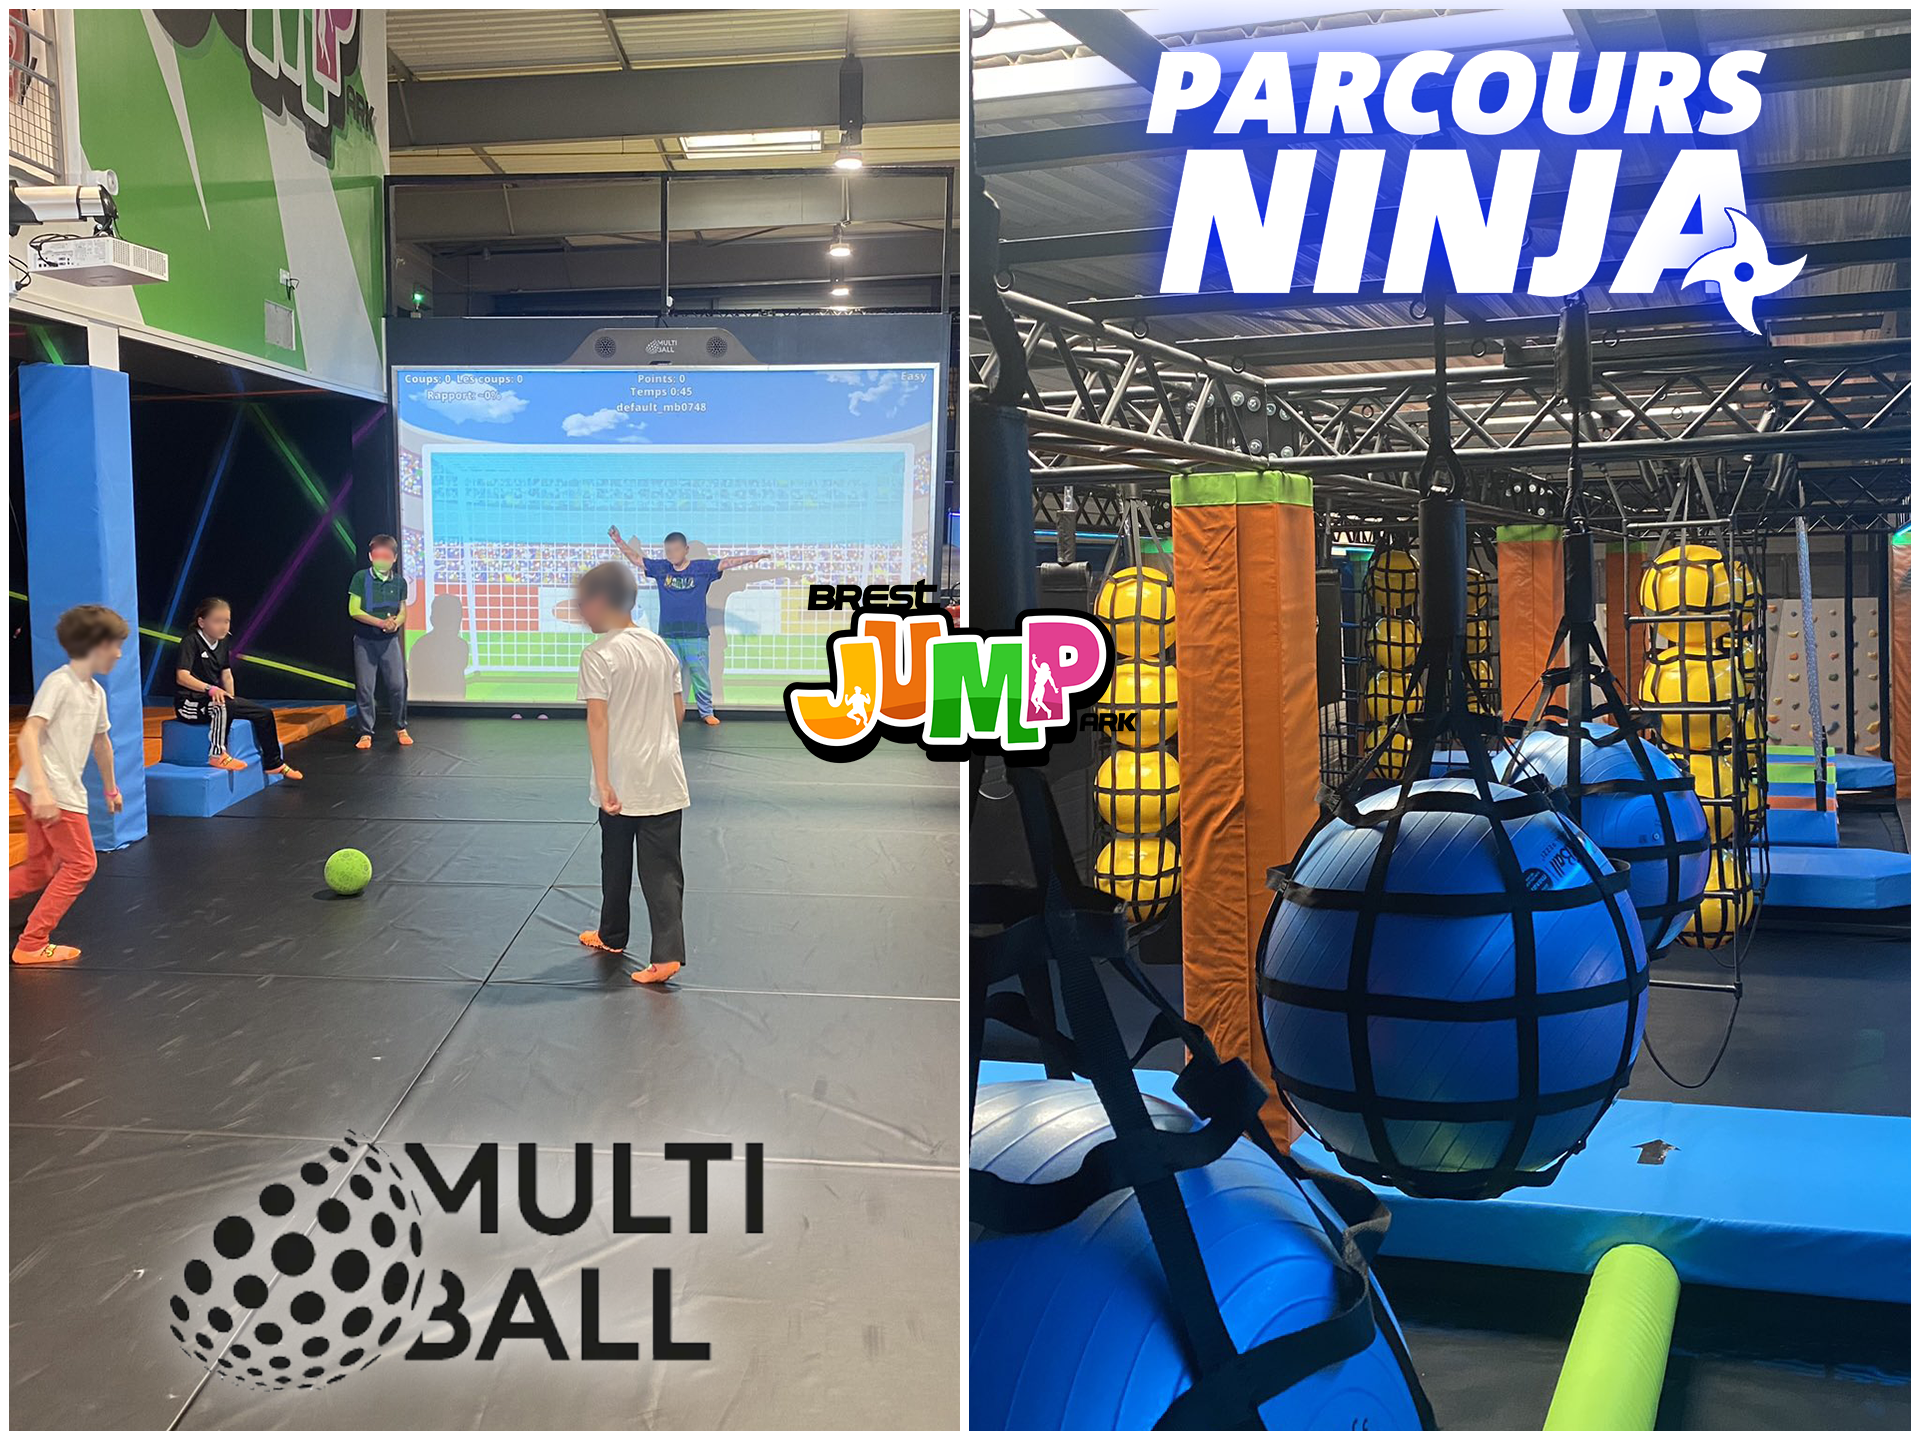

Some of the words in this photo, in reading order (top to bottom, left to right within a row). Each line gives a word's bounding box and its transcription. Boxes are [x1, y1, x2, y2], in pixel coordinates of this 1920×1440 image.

[346, 85, 375, 138] ARK
[658, 339, 678, 347] MULTI
[404, 374, 442, 385] Coups:
[445, 374, 451, 384] 0
[456, 374, 476, 384] Les
[478, 374, 514, 385] coups:
[516, 374, 523, 384] 0
[637, 374, 676, 384] Points:
[679, 374, 686, 384] 0
[900, 371, 927, 384] Easy
[427, 390, 476, 403] Rapport:
[630, 387, 668, 399] Temps
[670, 387, 693, 397] 0:45
[616, 402, 707, 415] default_mb0748
